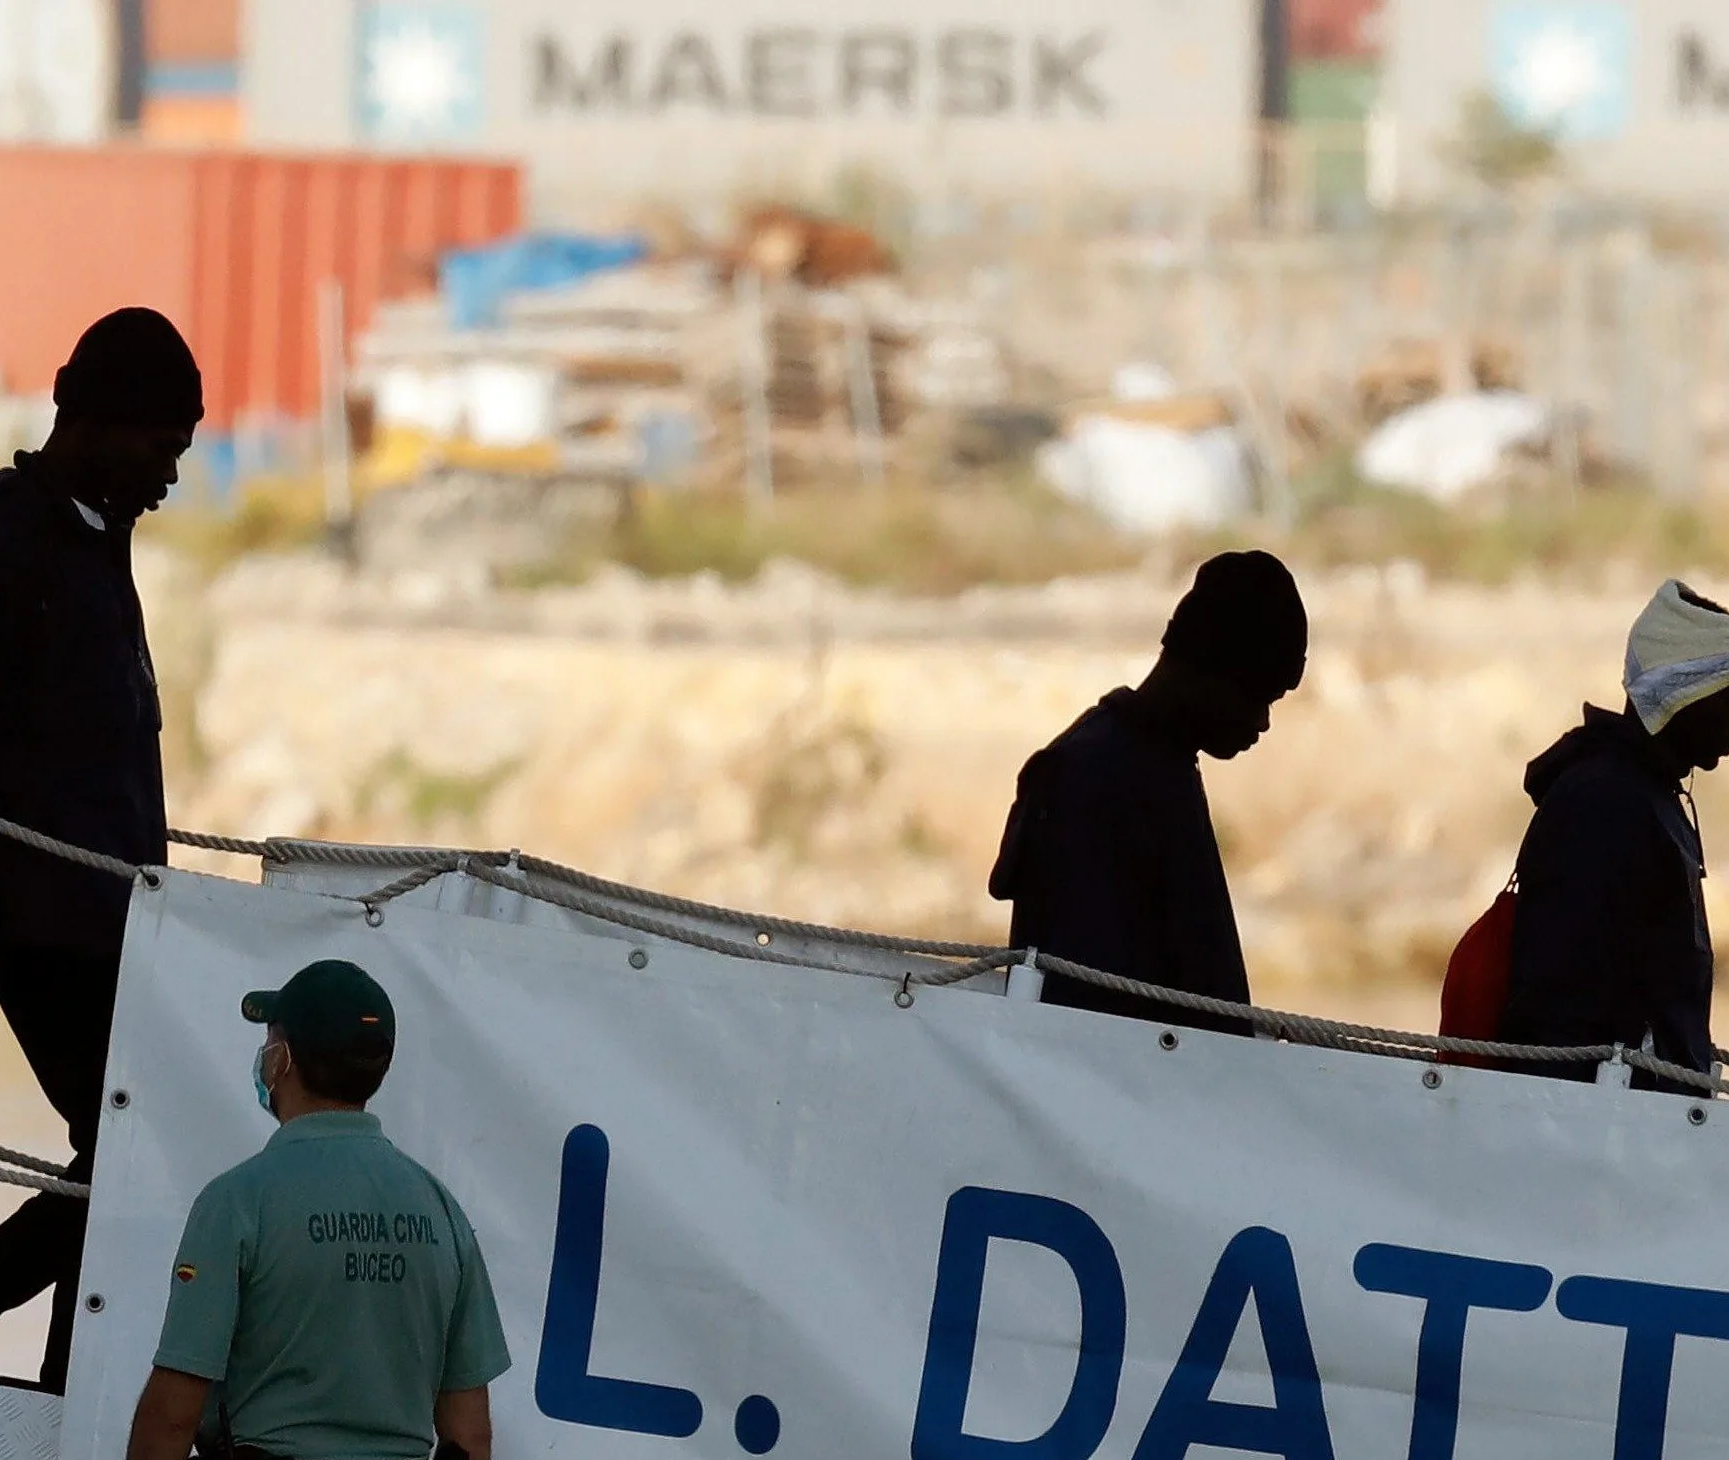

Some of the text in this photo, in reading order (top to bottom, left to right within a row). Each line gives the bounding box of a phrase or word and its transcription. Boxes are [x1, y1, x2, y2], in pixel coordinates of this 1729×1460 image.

[530, 26, 1116, 119] MAERSK
[307, 1211, 439, 1246] GUARDIA CIVIL
[343, 1251, 406, 1283] BUCEO
[535, 1123, 781, 1456] L.
